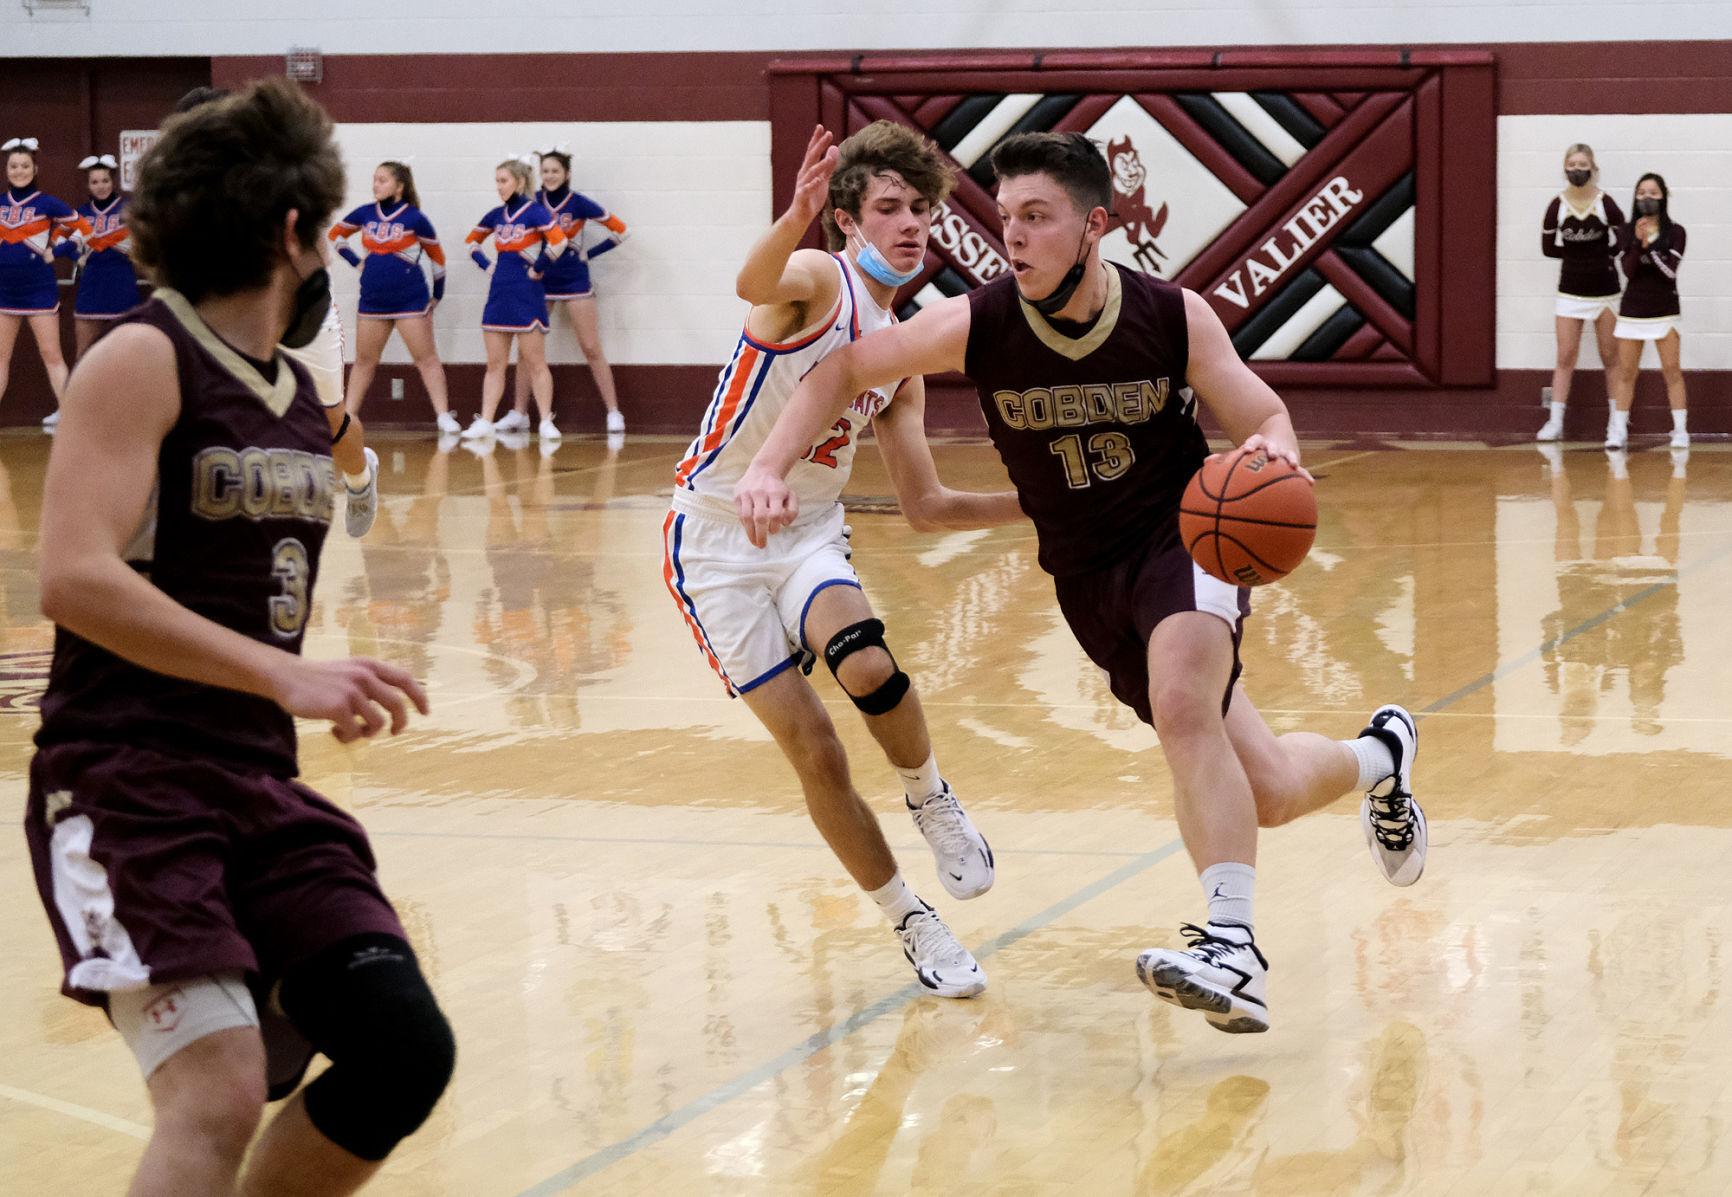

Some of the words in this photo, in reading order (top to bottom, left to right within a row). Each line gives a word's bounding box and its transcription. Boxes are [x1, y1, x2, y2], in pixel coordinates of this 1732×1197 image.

[929, 199, 1012, 285] ESSE
[1213, 176, 1363, 308] VALIER
[993, 377, 1169, 430] COBDEN
[1049, 432, 1136, 489] 13
[268, 537, 310, 639] 3
